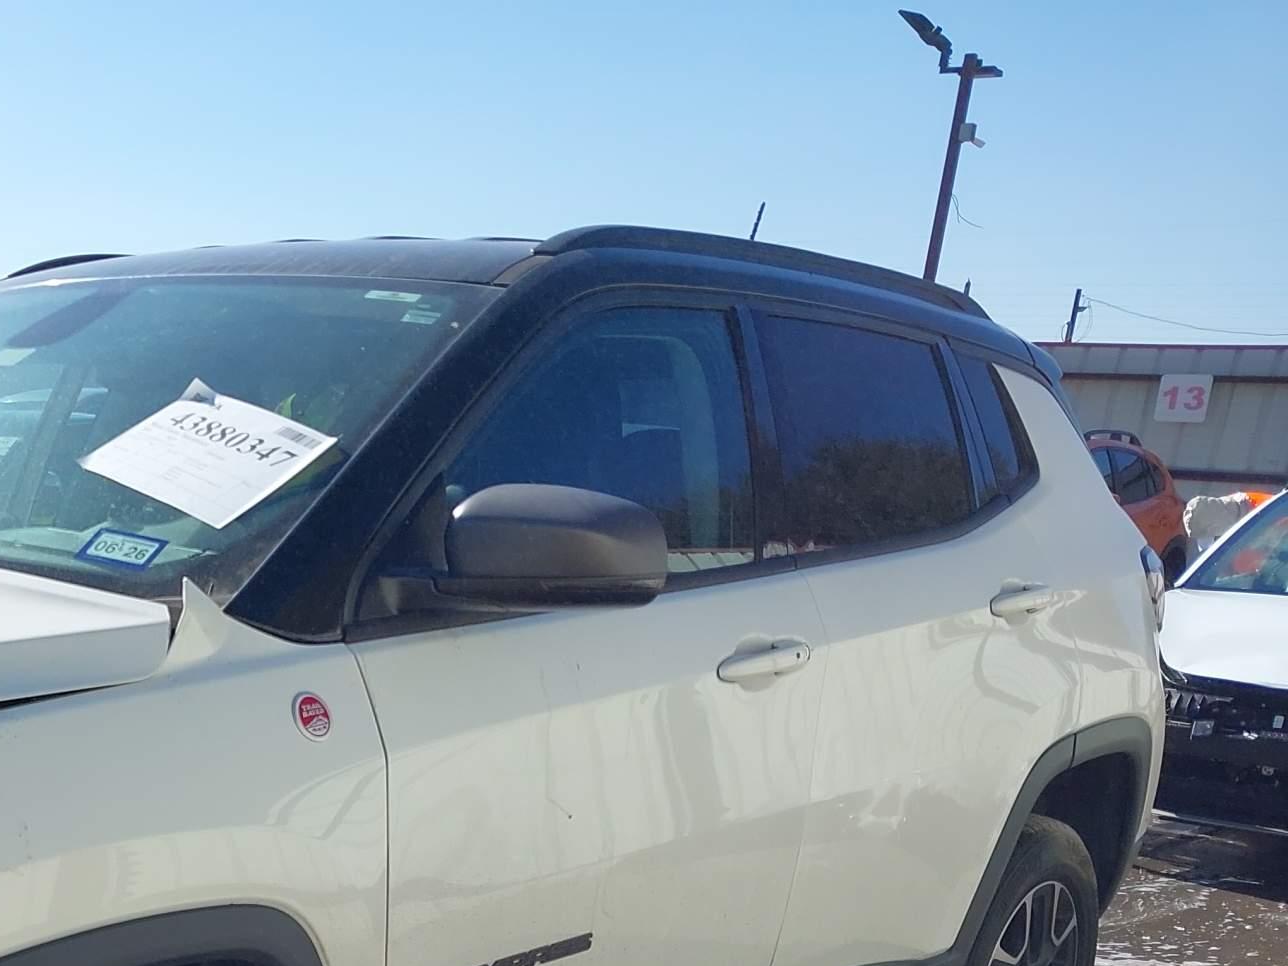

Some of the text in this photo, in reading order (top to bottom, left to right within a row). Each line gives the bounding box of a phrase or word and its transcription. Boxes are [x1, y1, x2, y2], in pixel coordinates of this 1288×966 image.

[1163, 385, 1206, 411] 13
[168, 411, 299, 467] 43880347
[93, 540, 150, 561] 06 26
